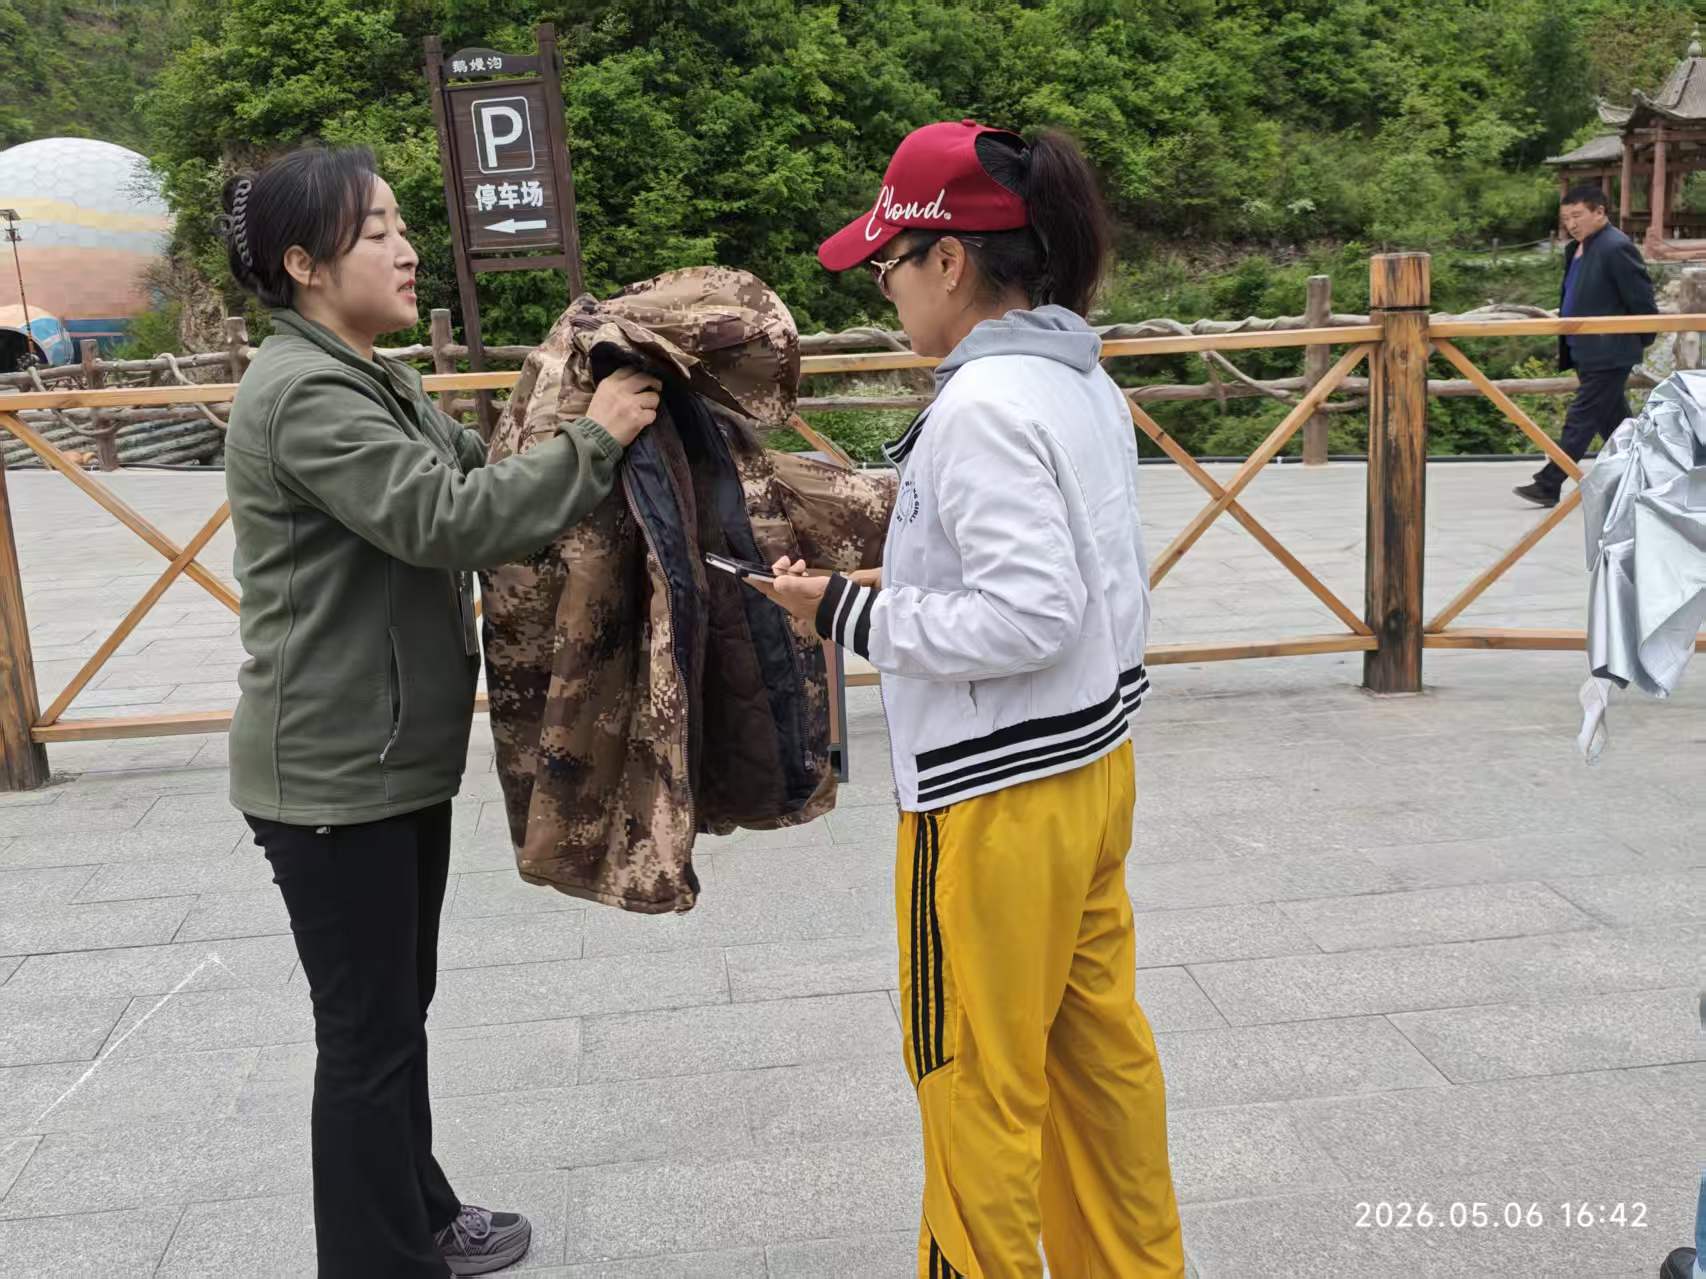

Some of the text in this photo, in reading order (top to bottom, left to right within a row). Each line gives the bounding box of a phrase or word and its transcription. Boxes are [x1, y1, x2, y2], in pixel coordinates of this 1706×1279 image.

[481, 106, 523, 168] P
[475, 181, 544, 211] 停车场
